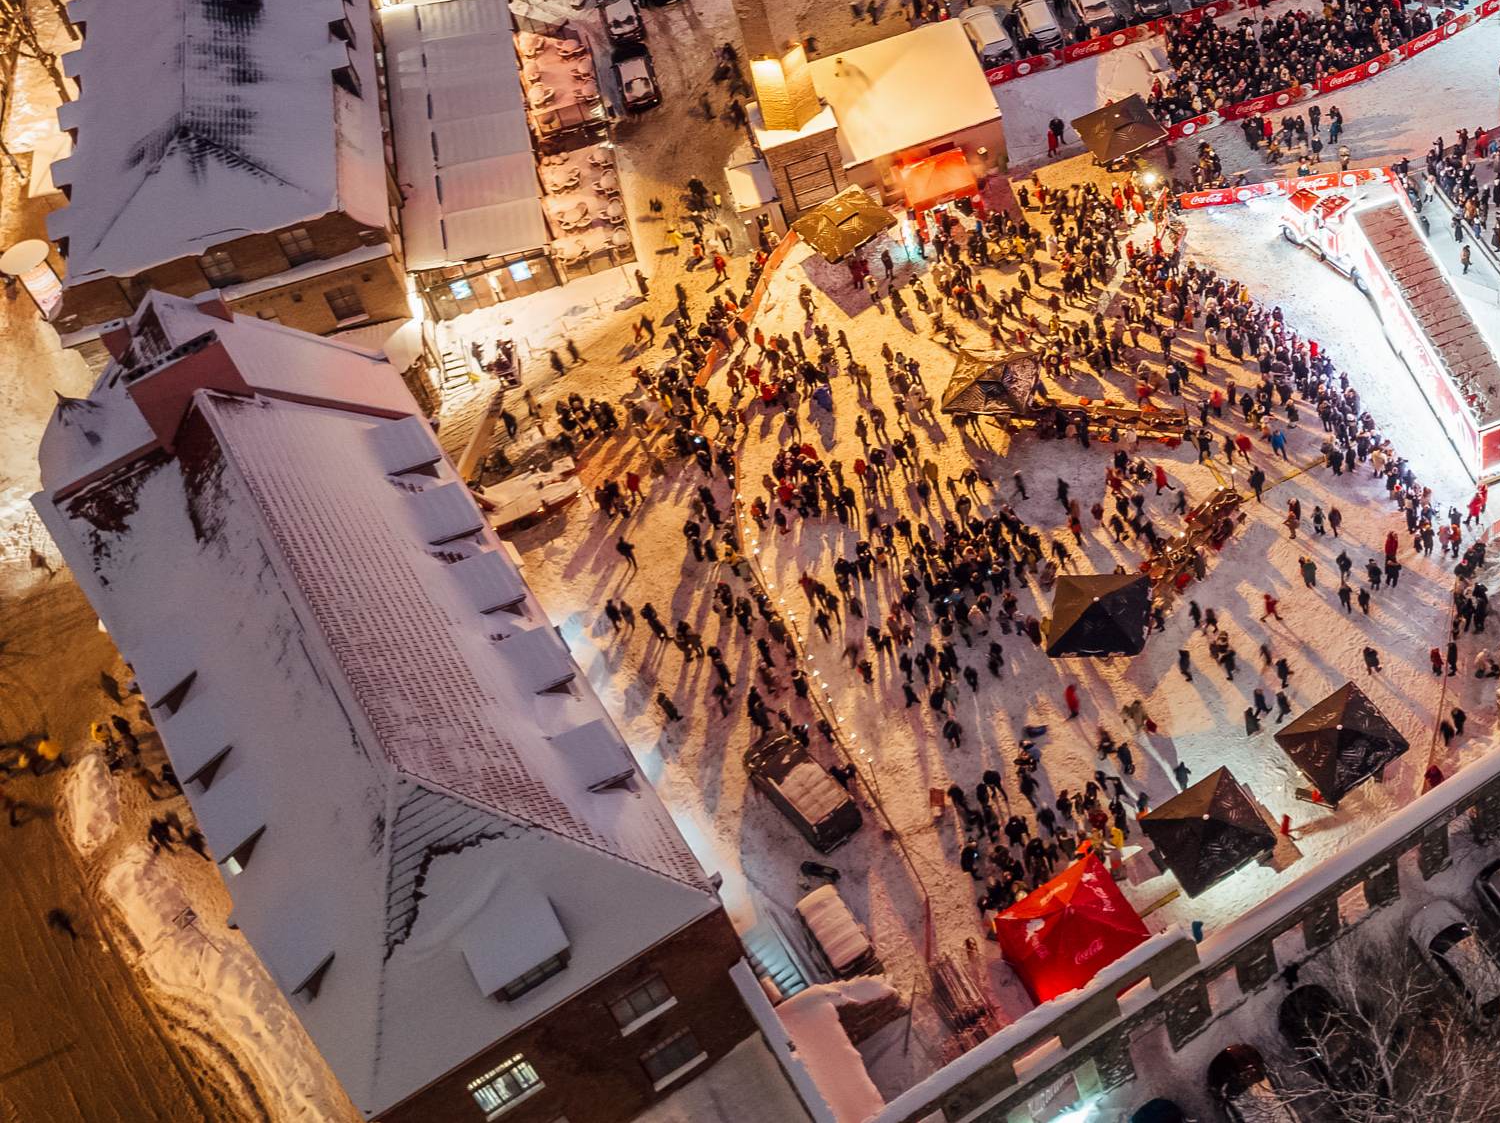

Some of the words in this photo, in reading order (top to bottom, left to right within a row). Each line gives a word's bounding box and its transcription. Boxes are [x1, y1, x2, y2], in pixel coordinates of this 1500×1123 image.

[1414, 33, 1437, 50] Coca-Cola
[1072, 42, 1100, 58] Coca-Cola
[1330, 71, 1356, 87] Coca-Cola
[1236, 100, 1265, 114] Coca-Cola
[1191, 193, 1222, 205] Coca-Cola
